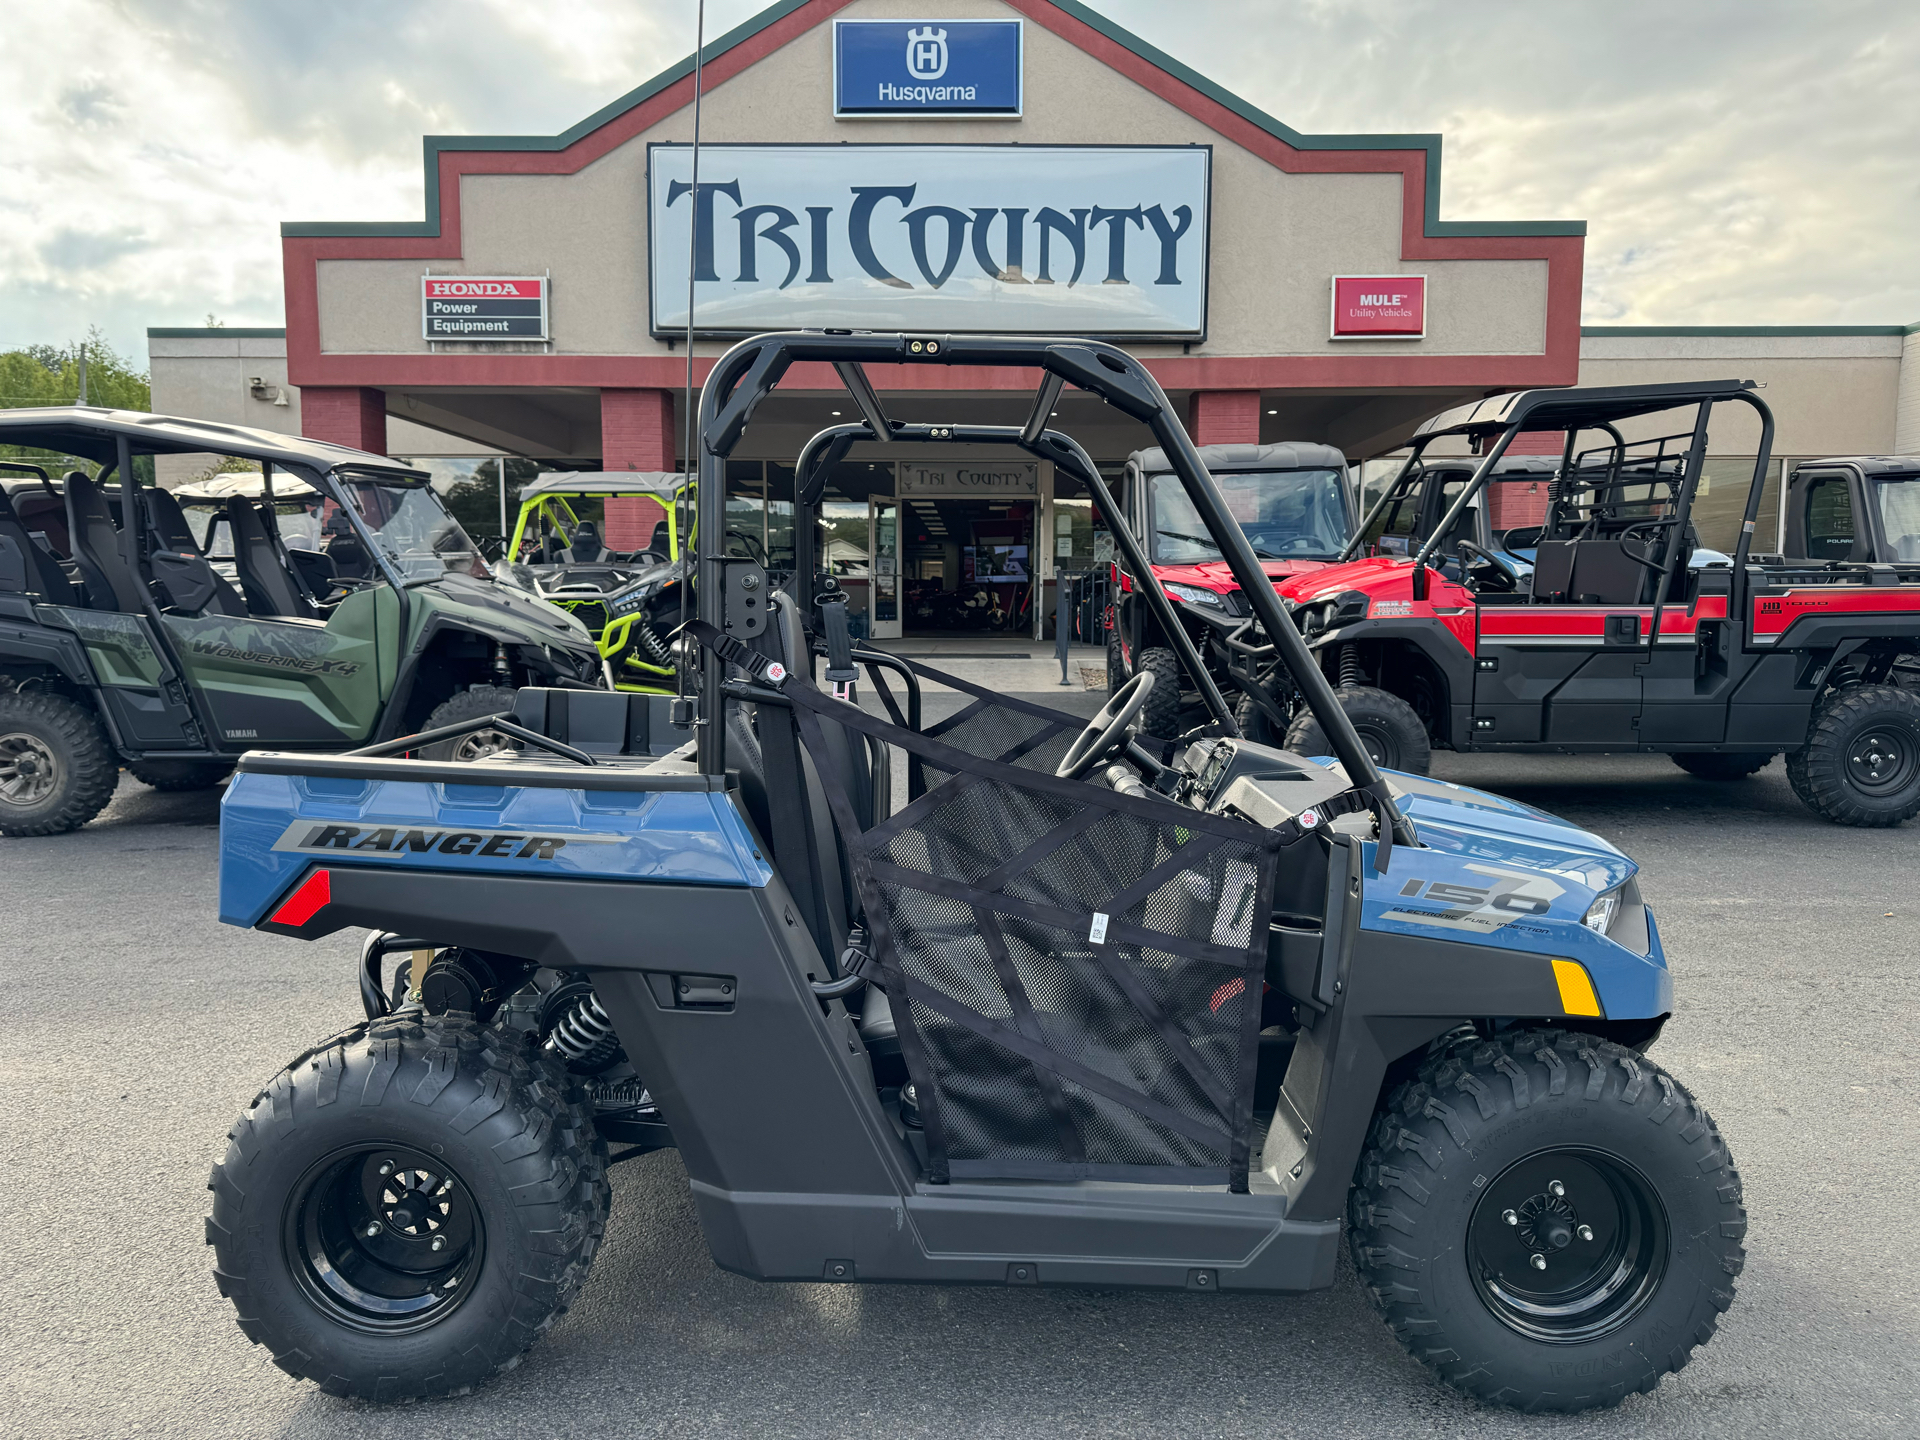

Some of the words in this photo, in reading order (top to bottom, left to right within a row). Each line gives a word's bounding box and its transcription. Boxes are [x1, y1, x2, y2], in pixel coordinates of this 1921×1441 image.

[878, 83, 976, 104] Husqvarna
[665, 176, 834, 290] TRI
[847, 181, 1193, 290] COUNTY
[432, 282, 520, 295] HONDA
[432, 301, 478, 313] Power
[1349, 308, 1376, 319] Utility
[1379, 308, 1412, 317] Vehicles
[433, 319, 509, 333] Equipment
[916, 469, 945, 486] TRI
[956, 469, 1022, 486] COUNTY
[1762, 602, 1781, 610] HD
[225, 729, 258, 739] YAMAHA
[311, 825, 567, 860] RANGER
[1398, 878, 1552, 916] 150
[1392, 906, 1459, 920] ELECTRONIC
[1463, 917, 1492, 926] FUEL
[1496, 922, 1550, 935] INJECTION
